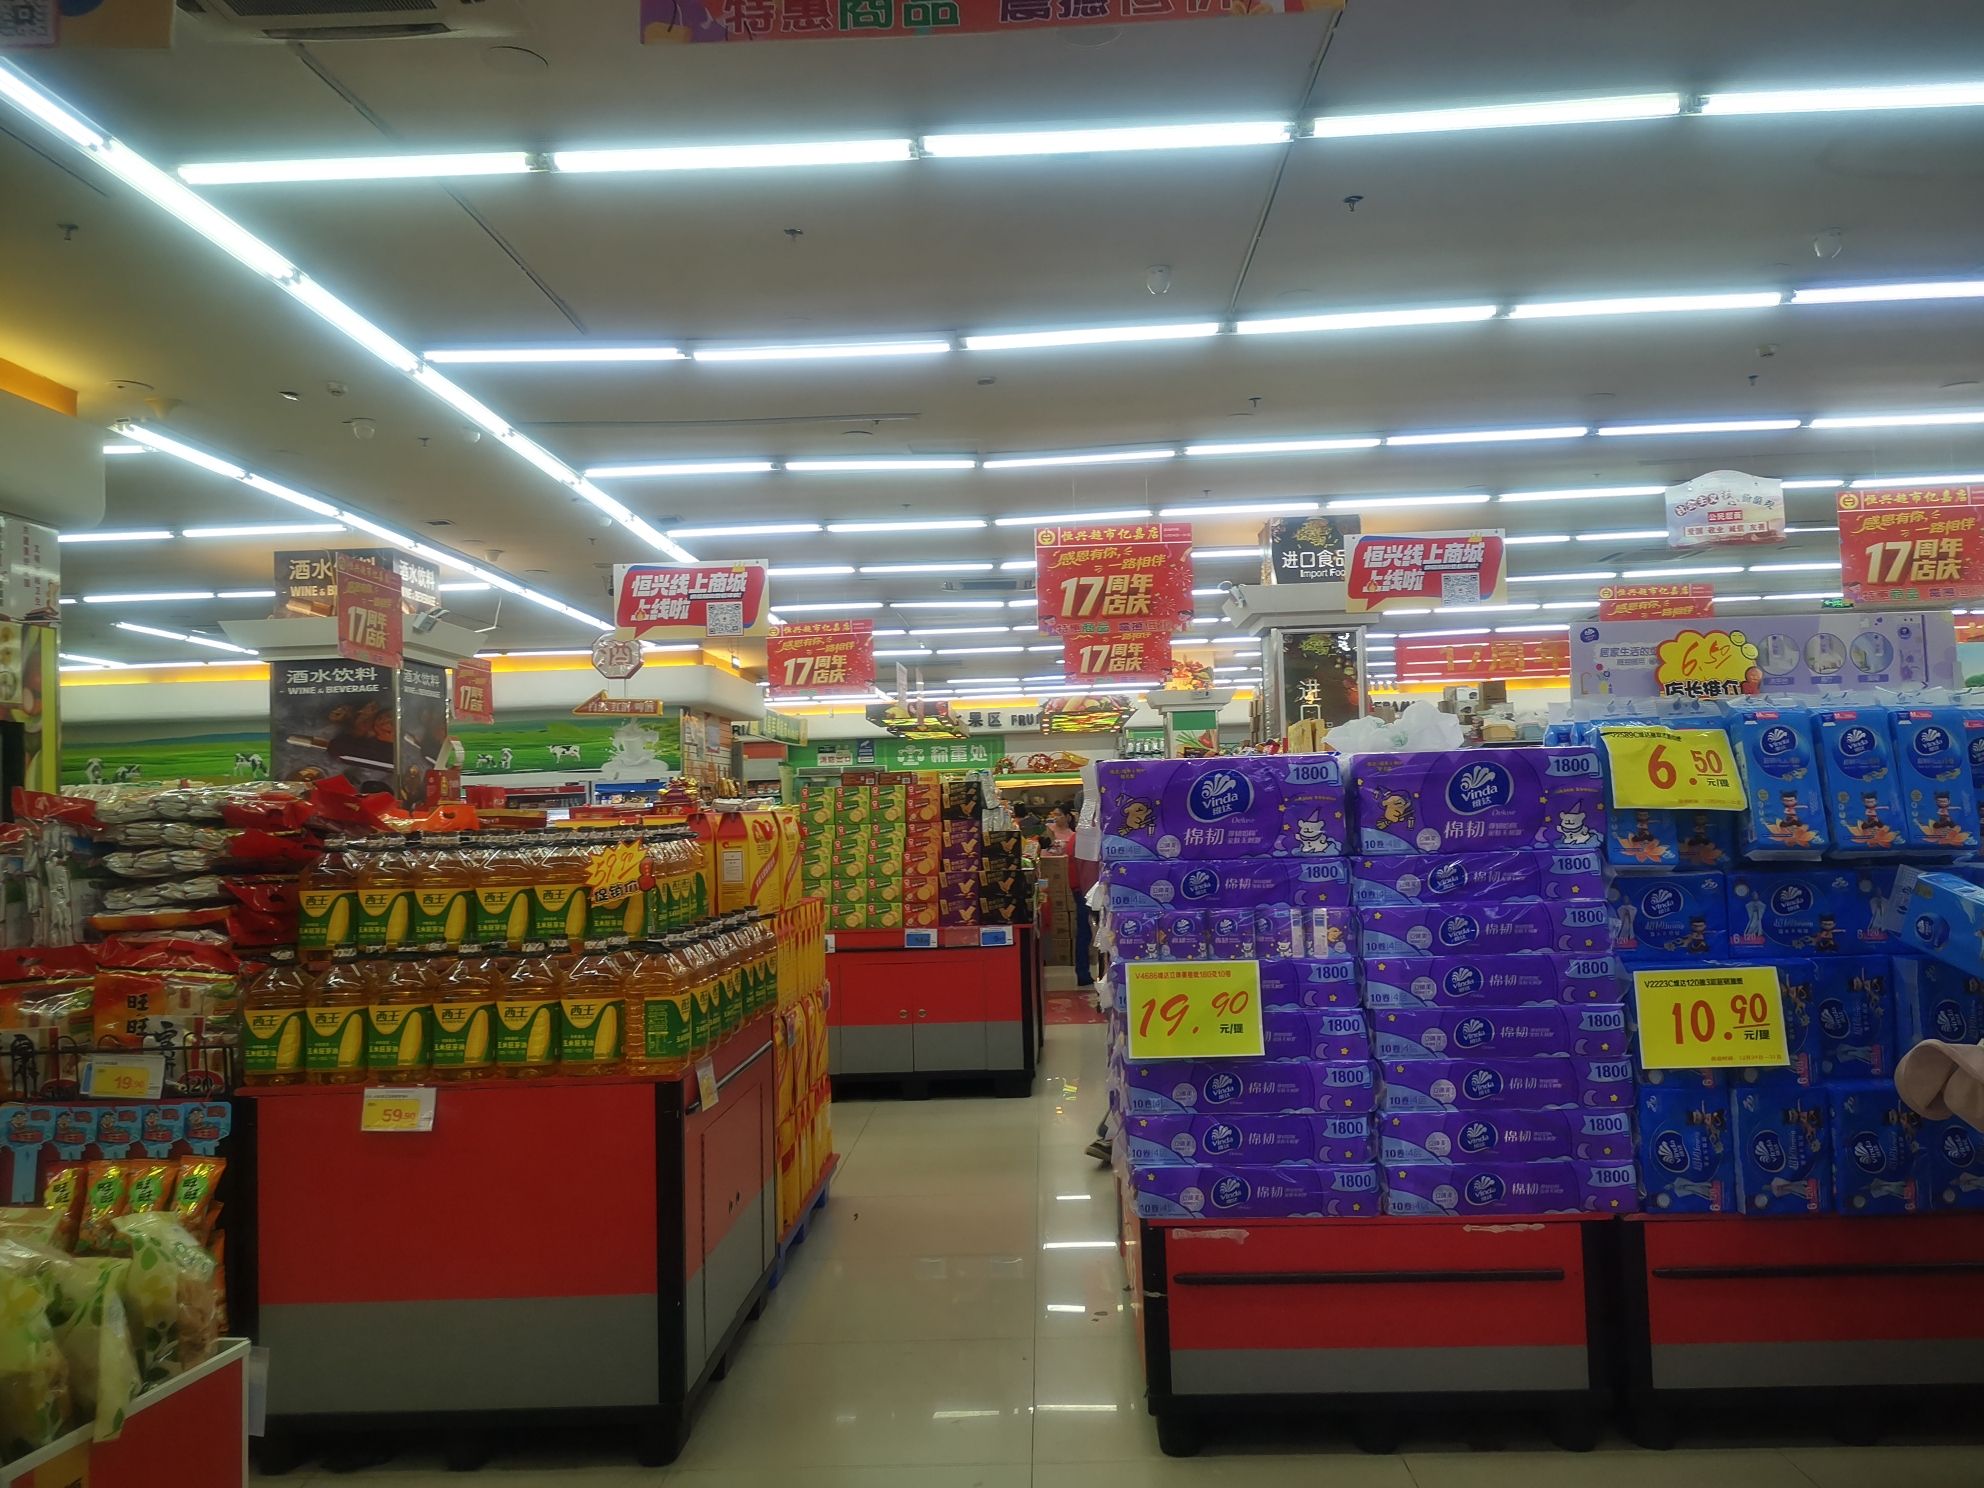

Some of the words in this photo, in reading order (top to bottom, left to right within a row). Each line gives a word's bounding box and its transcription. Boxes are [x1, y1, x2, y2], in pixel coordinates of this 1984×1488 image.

[1363, 542, 1485, 569] 恒兴线上商城
[1300, 569, 1328, 579] Import
[631, 572, 748, 596] 恒兴线上商城
[1362, 571, 1425, 592] 上线啦
[290, 586, 318, 597] WINE
[630, 599, 691, 621] 上线啦
[286, 667, 378, 684] 酒水饮料
[288, 687, 315, 696] WINE
[326, 684, 380, 694] BEVERAGE
[1553, 758, 1589, 772] 1800
[1293, 766, 1328, 780] 1800
[1461, 784, 1498, 802] Vinda
[1203, 793, 1239, 809] Vinda
[1444, 820, 1484, 839] 棉韧
[1184, 828, 1223, 846] 棉韧
[1558, 857, 1591, 870] 1800
[1306, 866, 1339, 878] 1800
[306, 896, 329, 906] 西王
[365, 895, 388, 905] 西王
[423, 894, 446, 904] 西王
[484, 893, 506, 902] 西王
[543, 890, 564, 900] 西王
[1571, 910, 1604, 923] 1800
[1315, 966, 1349, 979] 1800
[1575, 961, 1608, 974] 1800
[376, 1011, 399, 1022] 西王
[442, 1009, 466, 1020] 西王
[504, 1007, 528, 1018] 西王
[571, 1005, 596, 1017] 西王
[252, 1015, 277, 1026] 西王
[315, 1013, 339, 1024] 西王
[1587, 1014, 1621, 1028] 1800
[1327, 1019, 1360, 1032] 1800
[1744, 1030, 1770, 1040] 元/提
[1331, 1070, 1364, 1083] 1800
[1595, 1064, 1628, 1078] 1800
[1331, 1122, 1363, 1134] 1800
[1589, 1117, 1622, 1131] 1800
[1339, 1174, 1371, 1188] 1800
[1596, 1169, 1629, 1183] 1800
